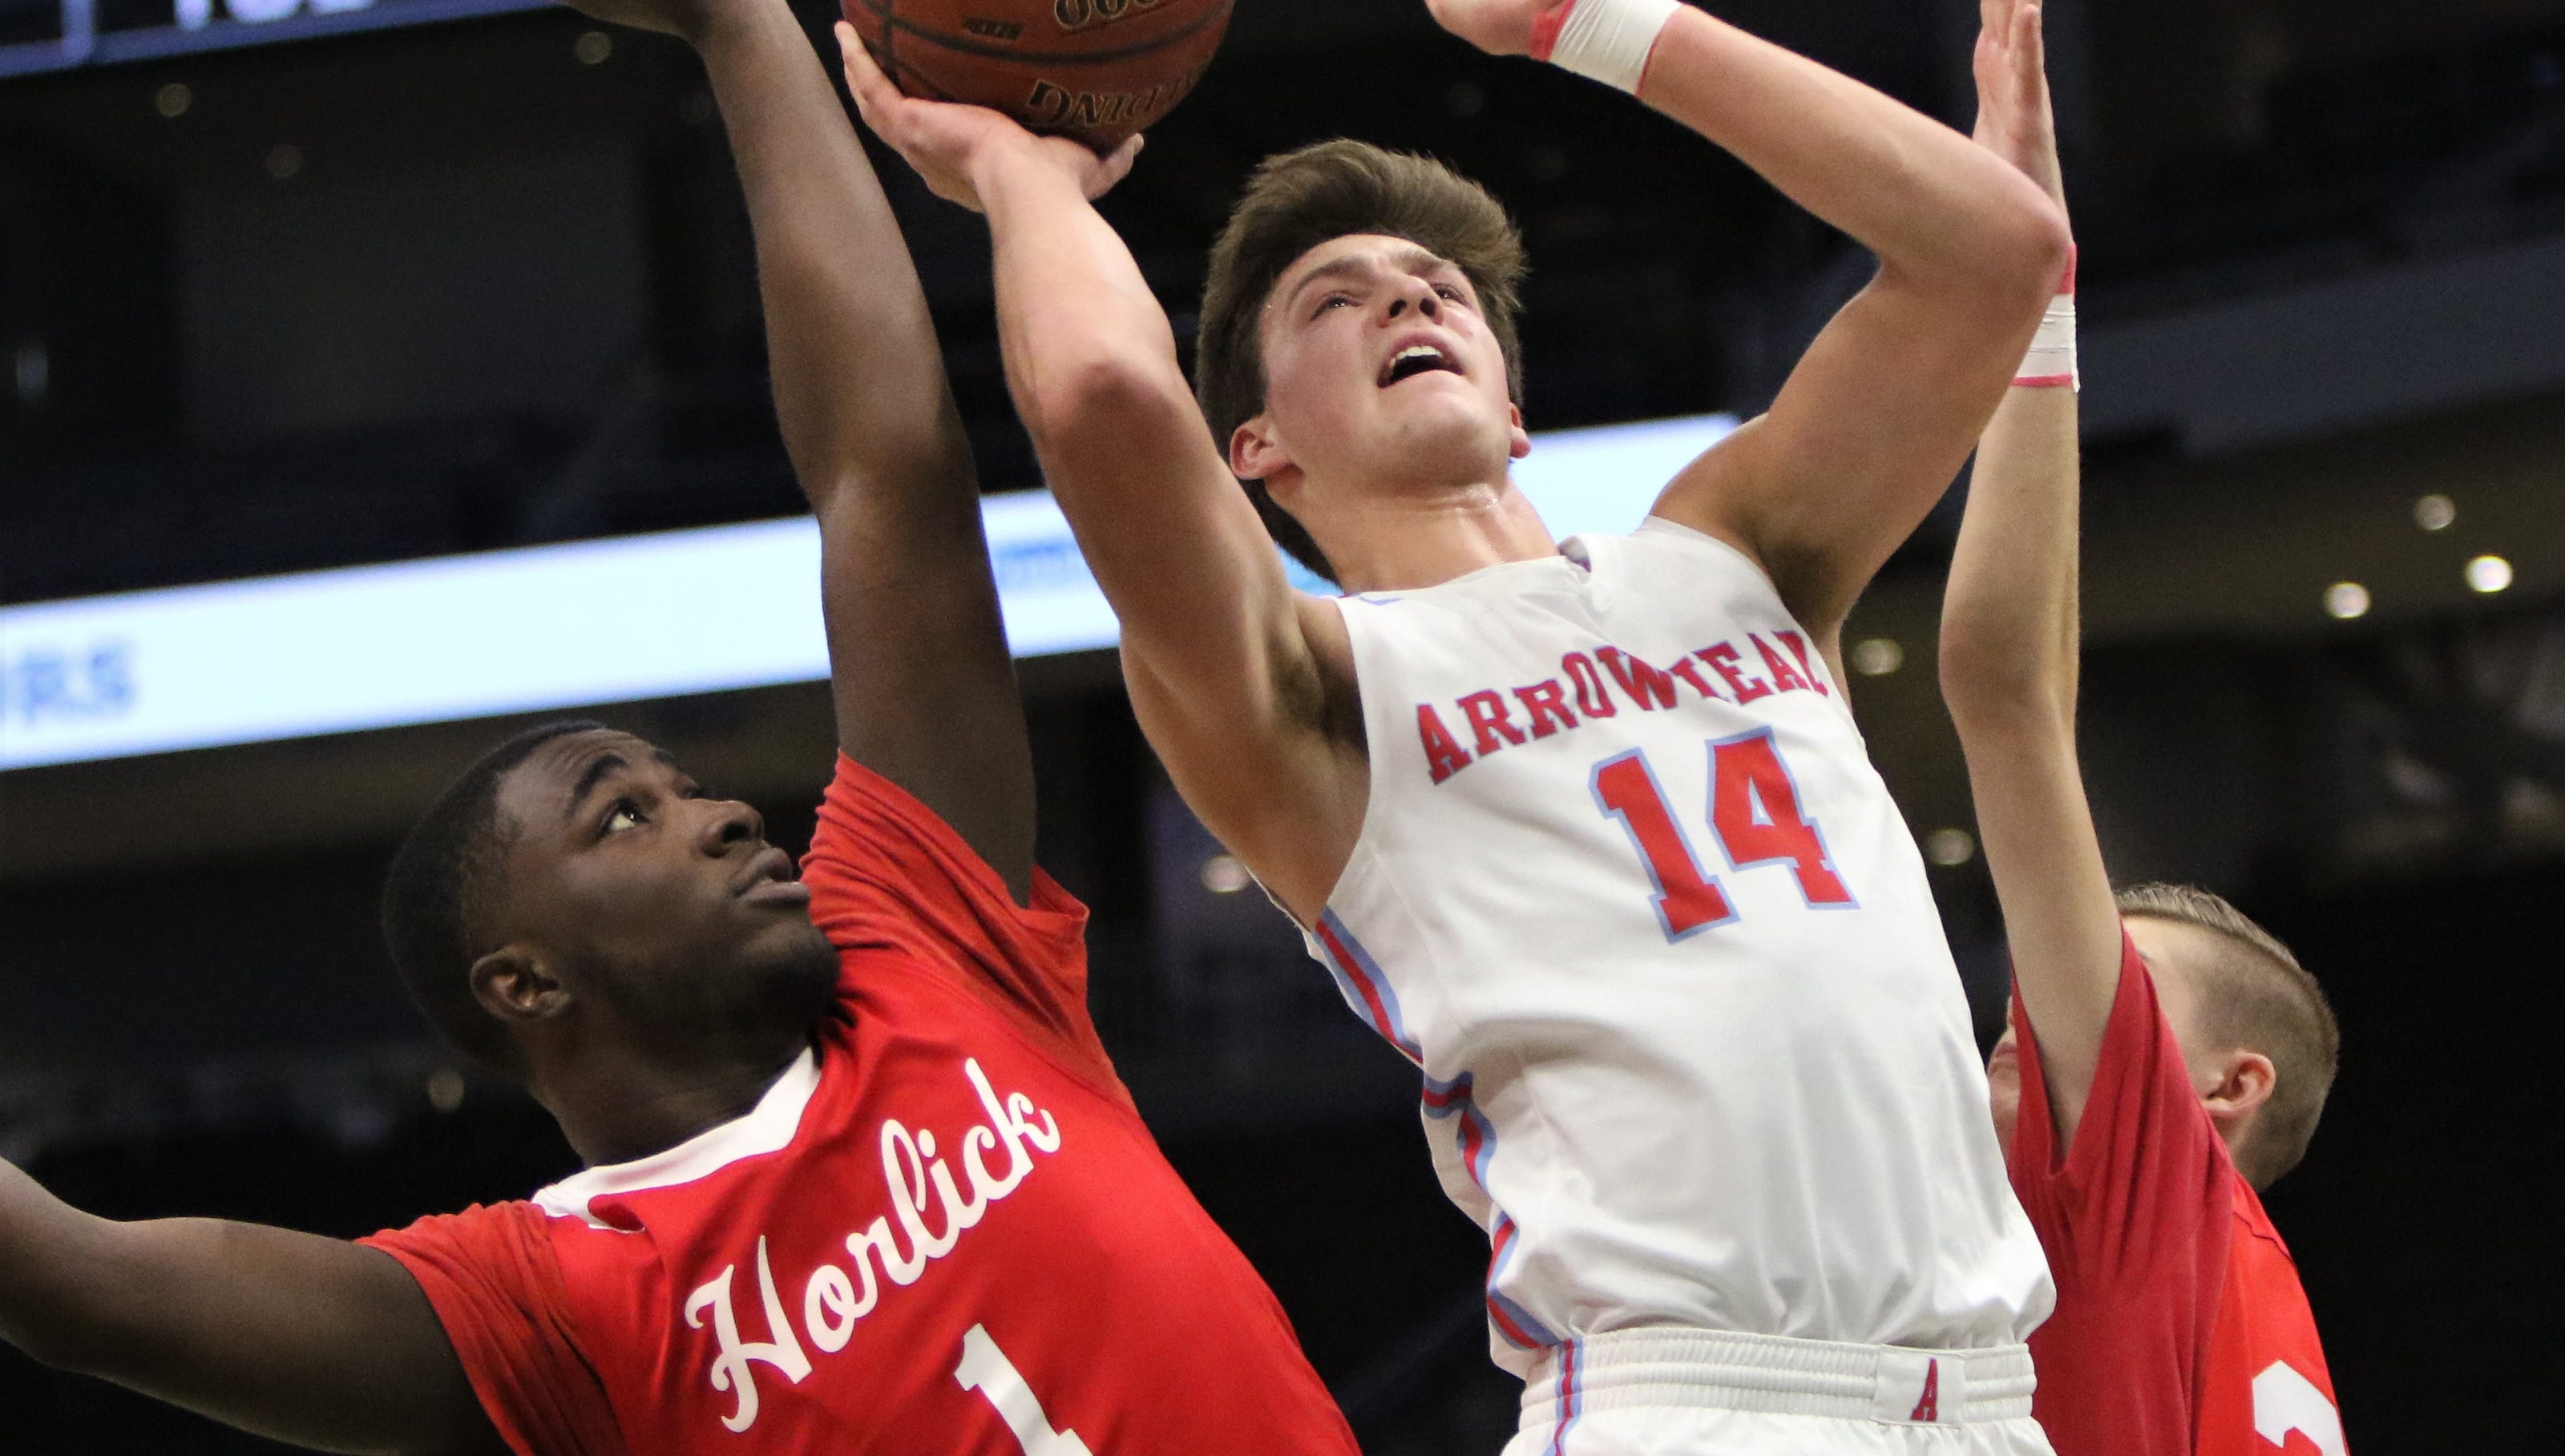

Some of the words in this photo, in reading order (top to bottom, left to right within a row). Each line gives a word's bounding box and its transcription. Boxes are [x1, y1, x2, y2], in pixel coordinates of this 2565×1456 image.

[1589, 725, 1860, 944] 14
[685, 1057, 1060, 1433] Horlick
[954, 1322, 1093, 1456] 1
[1910, 1357, 1937, 1422] A
